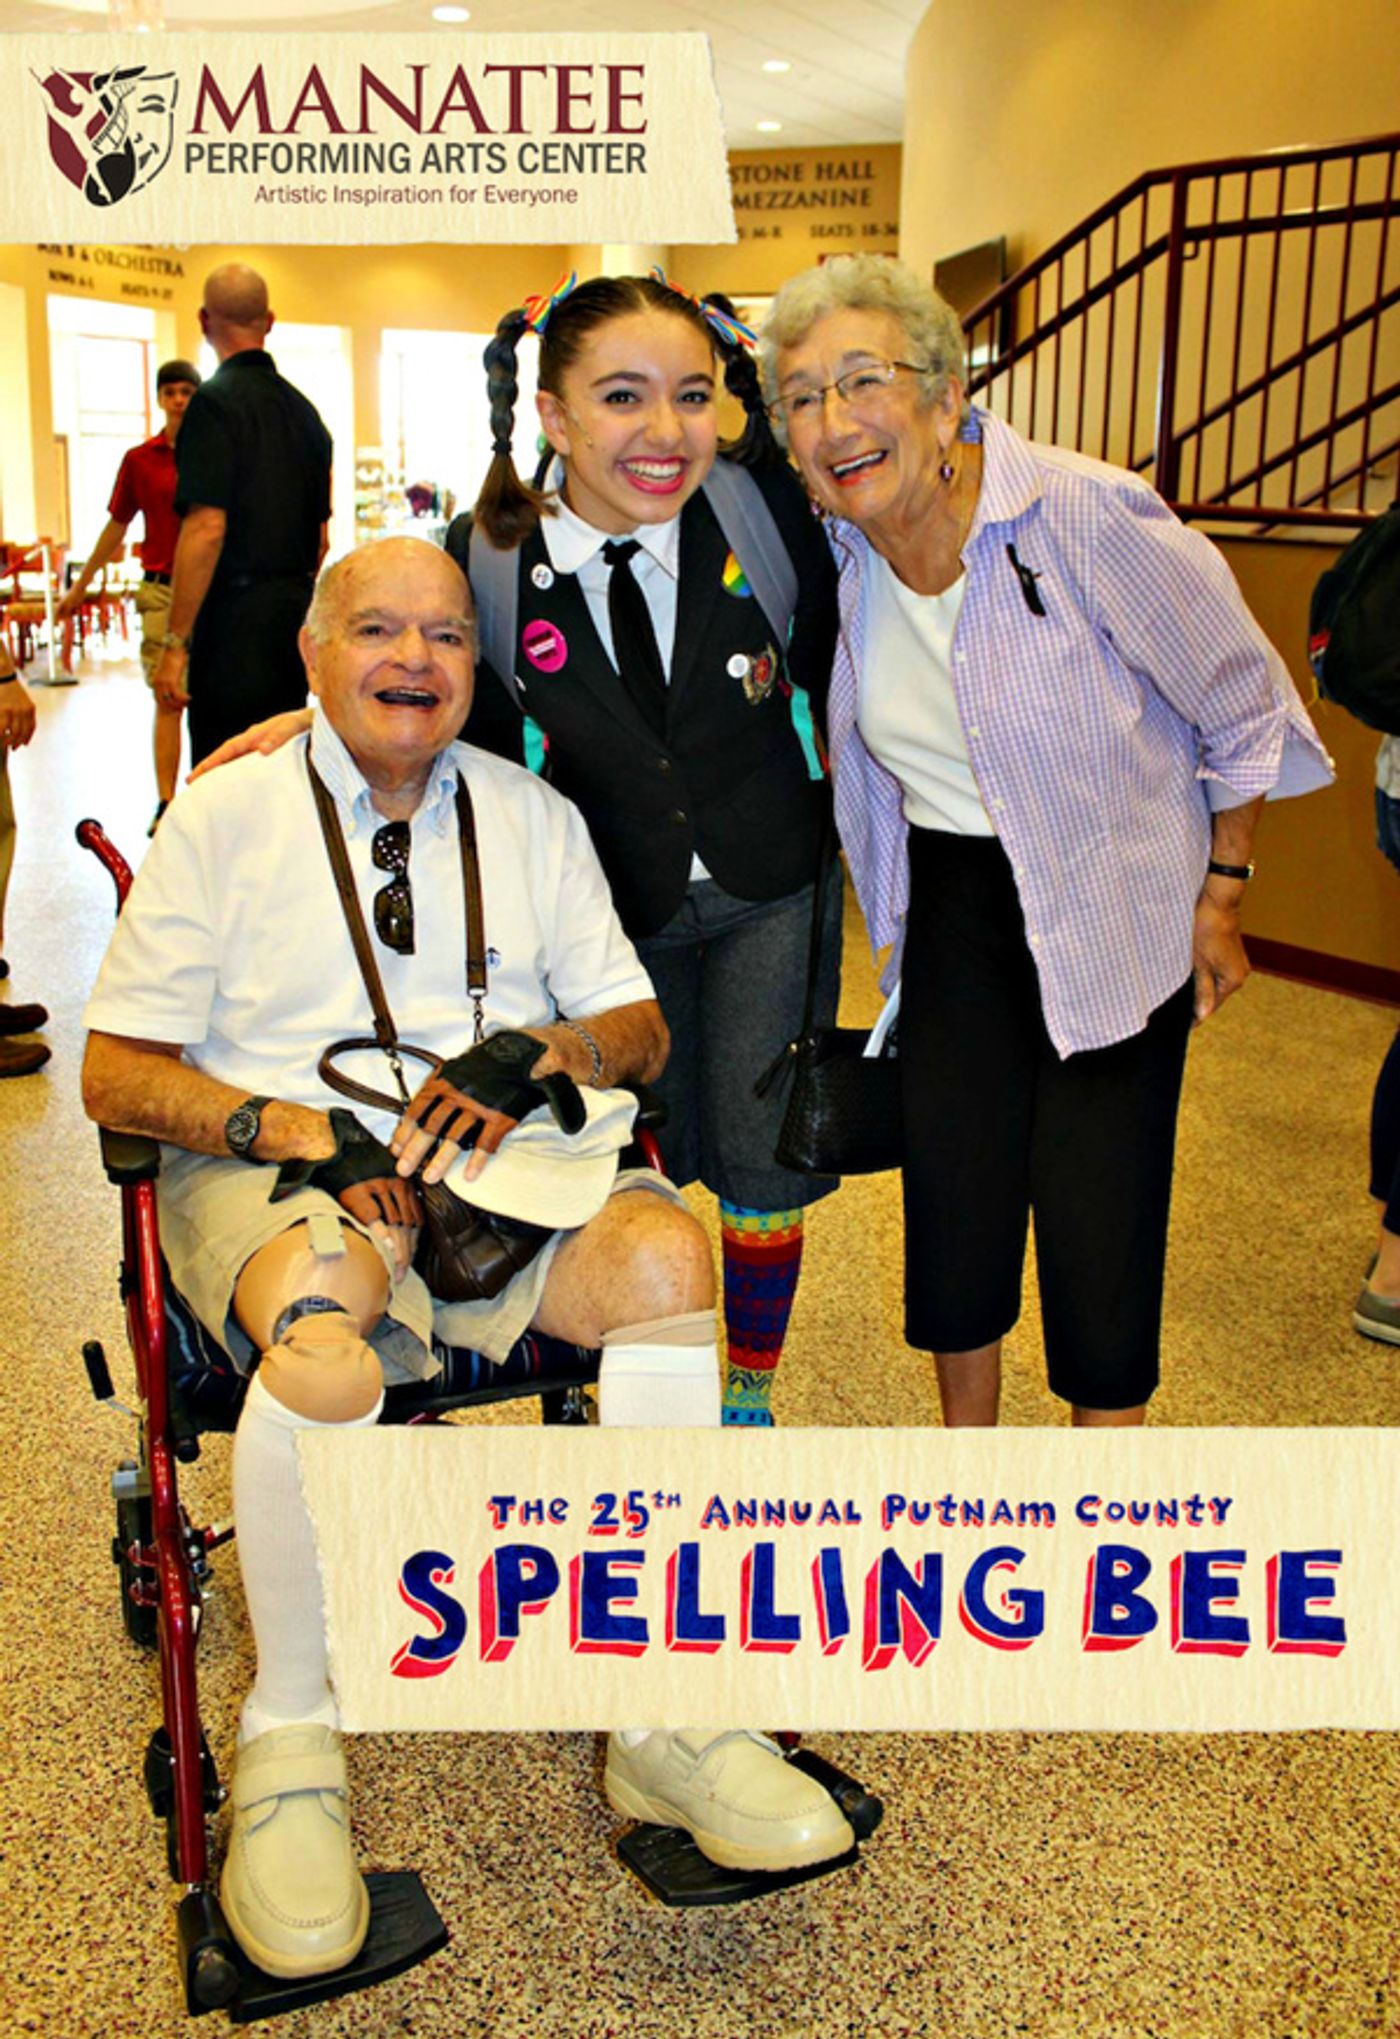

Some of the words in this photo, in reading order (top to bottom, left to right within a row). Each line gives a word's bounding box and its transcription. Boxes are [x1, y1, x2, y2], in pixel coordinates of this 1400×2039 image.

[730, 162, 804, 183] STONE
[815, 160, 875, 181] HALL
[733, 187, 872, 210] MEZZANINE
[810, 223, 854, 239] SEATS
[93, 247, 184, 277] ORCHESTRA
